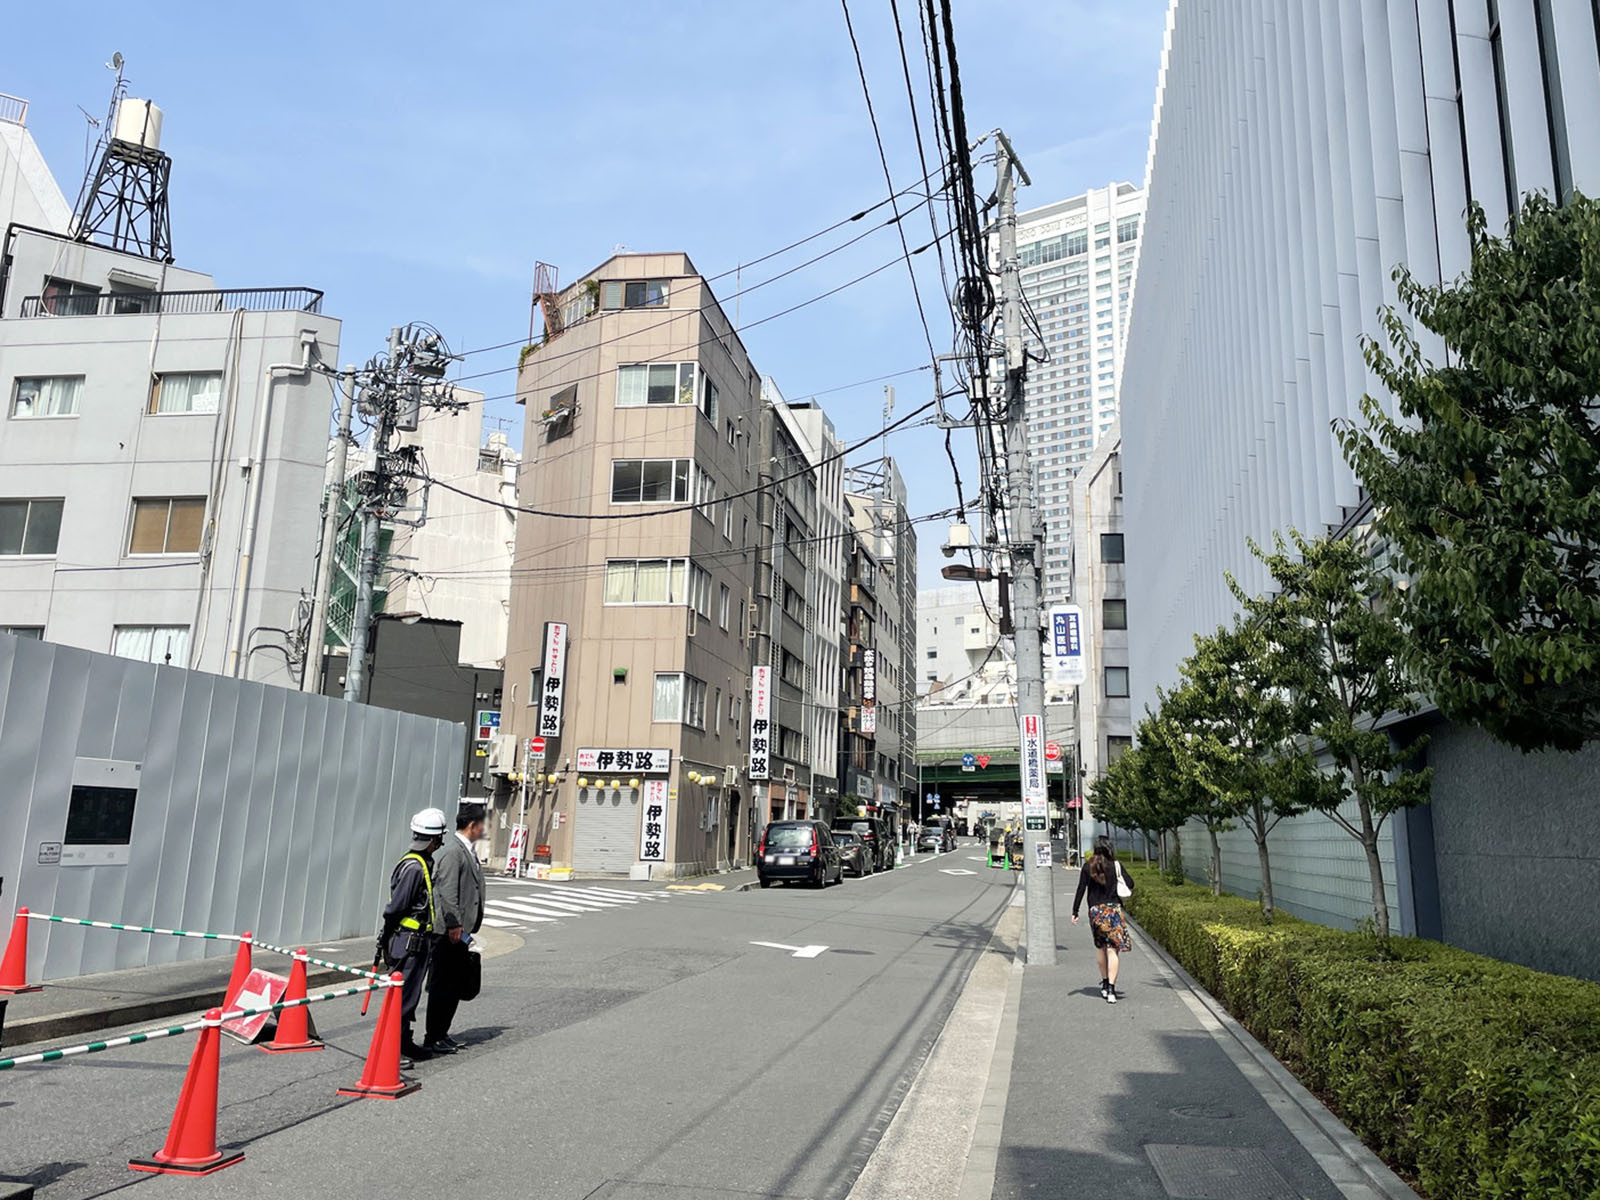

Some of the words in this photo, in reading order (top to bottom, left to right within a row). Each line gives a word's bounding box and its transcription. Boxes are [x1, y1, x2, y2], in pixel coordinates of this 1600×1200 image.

[1055, 615, 1067, 655] 丸山医院
[542, 676, 561, 731] 伊勢路
[579, 752, 594, 760] おでん
[596, 751, 654, 770] 伊勢路
[751, 718, 768, 773] 伊勢路
[1027, 738, 1040, 789] 水道橋薬局
[644, 804, 663, 858] 伊勢路
